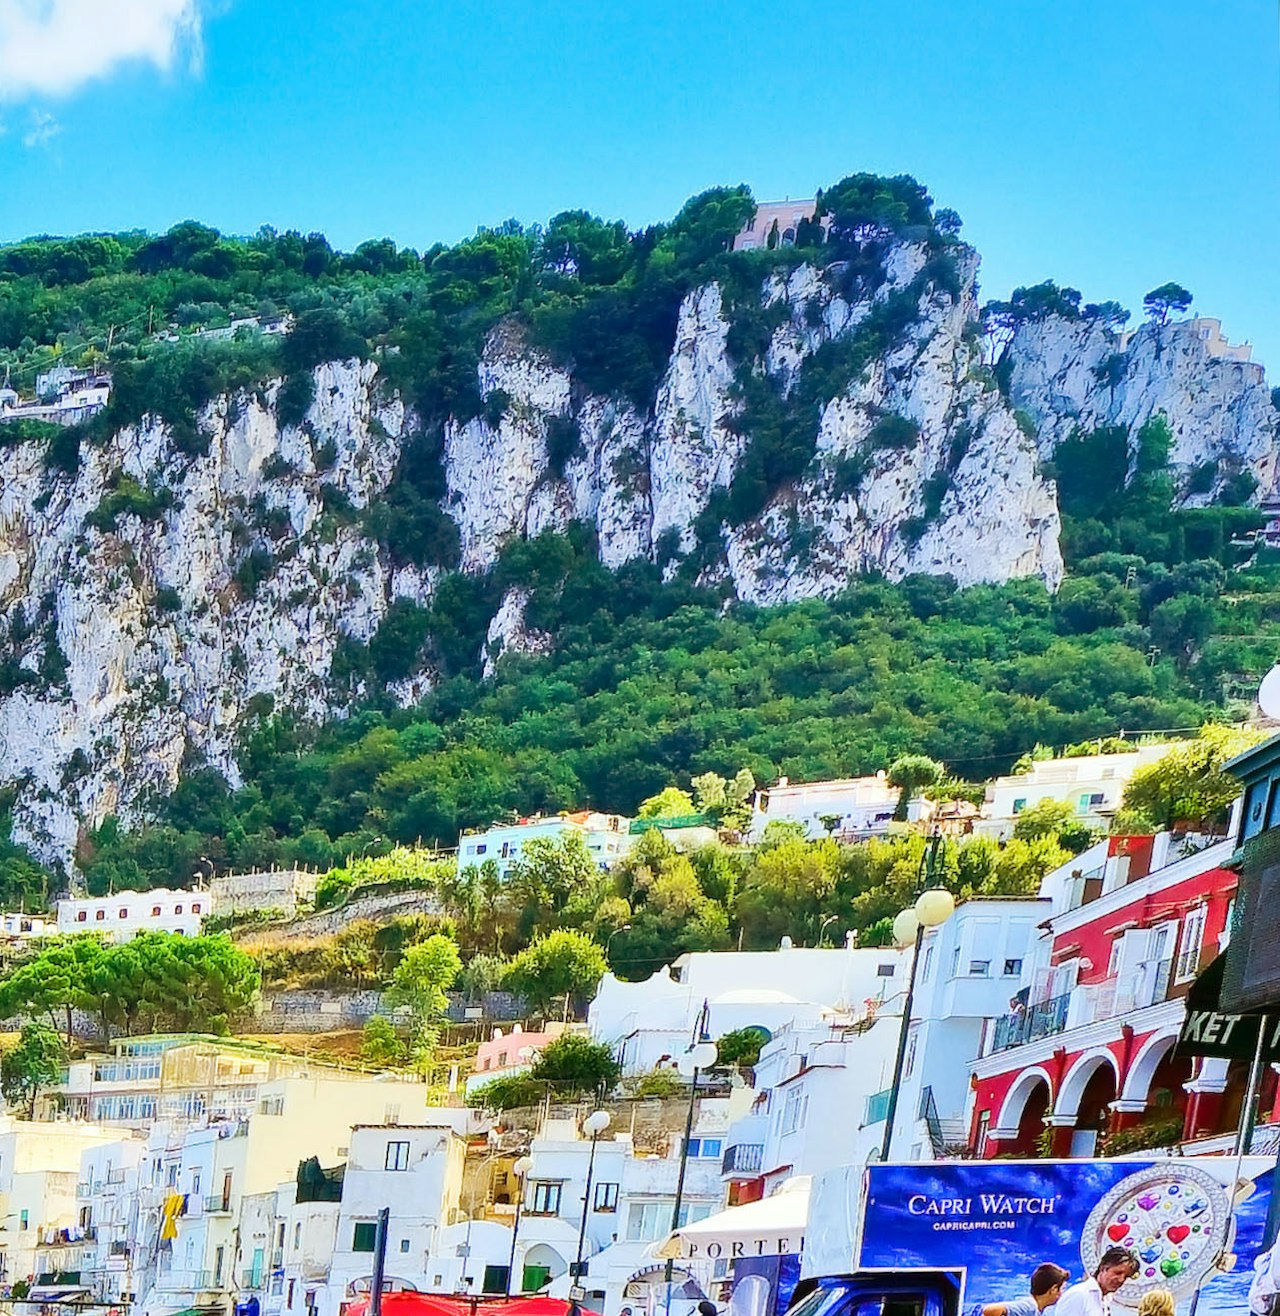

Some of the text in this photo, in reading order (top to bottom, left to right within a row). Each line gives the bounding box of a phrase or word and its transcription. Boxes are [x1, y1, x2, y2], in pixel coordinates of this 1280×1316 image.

[908, 1194, 1055, 1215] CAPRI WATCH
[932, 1220, 1015, 1231] CAPRICAPRI.COM
